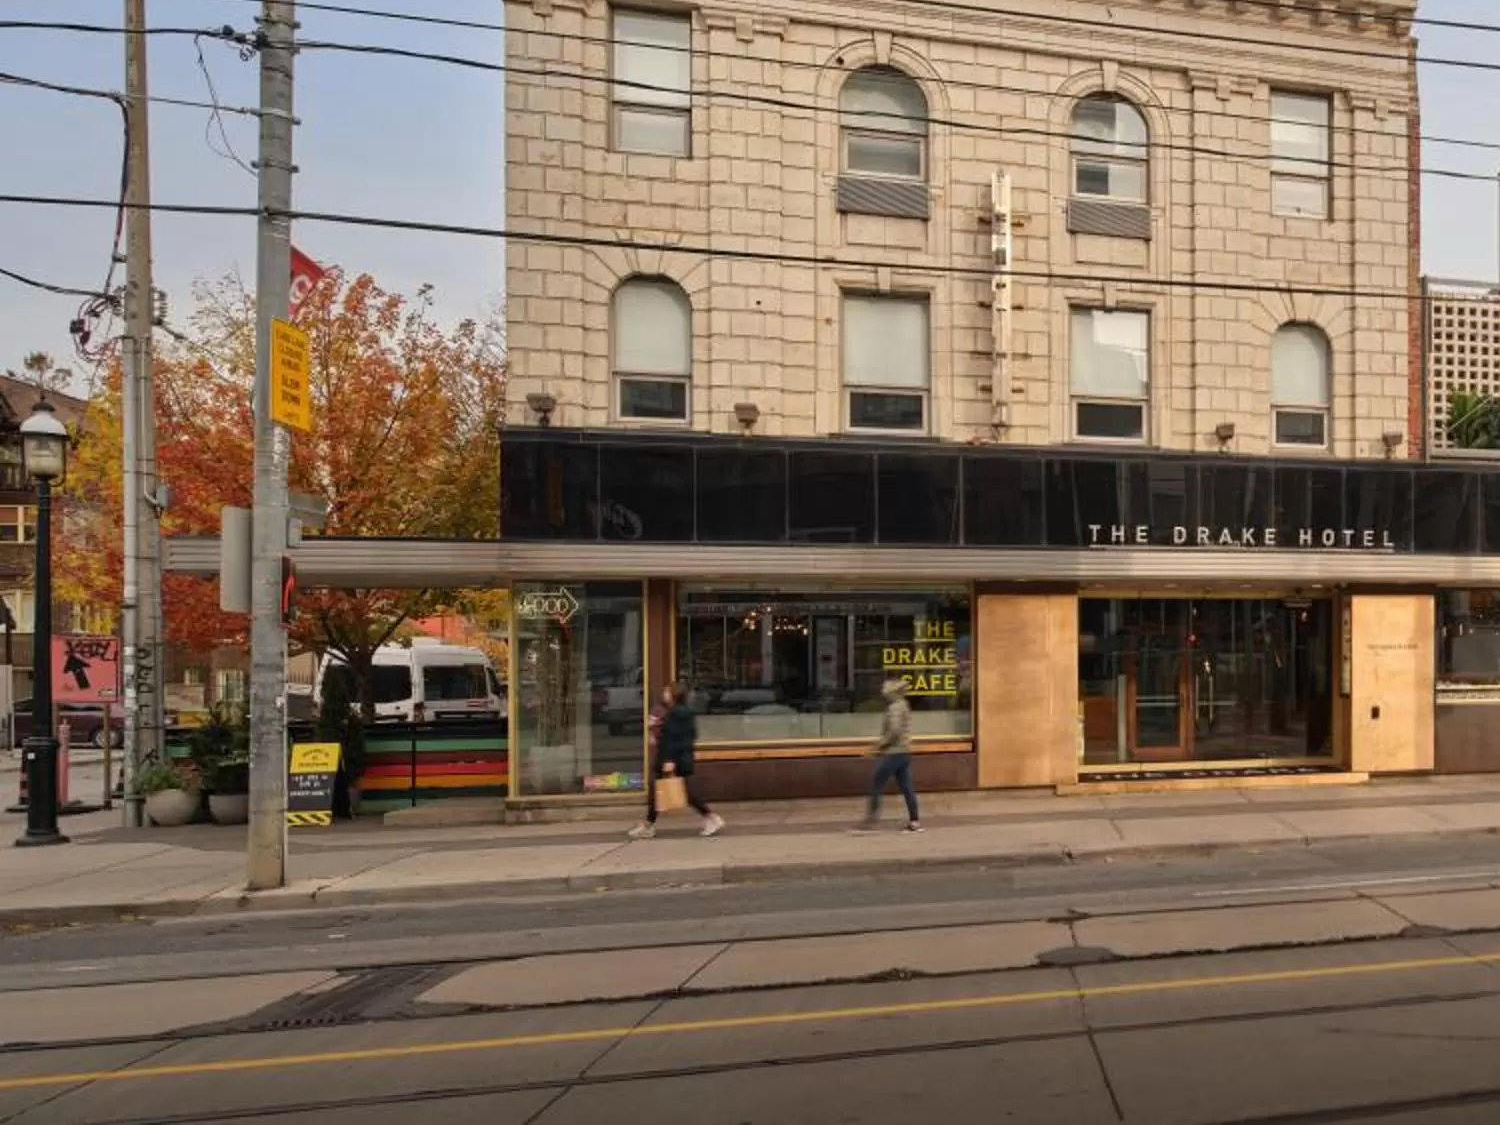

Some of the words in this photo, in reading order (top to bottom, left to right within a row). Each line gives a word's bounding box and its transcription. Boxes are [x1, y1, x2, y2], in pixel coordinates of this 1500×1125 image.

[1088, 524, 1149, 543] THE
[1173, 525, 1277, 546] DRAKE
[1299, 527, 1395, 547] HOTEL
[913, 619, 956, 637] THE
[882, 648, 957, 665] DRAKE
